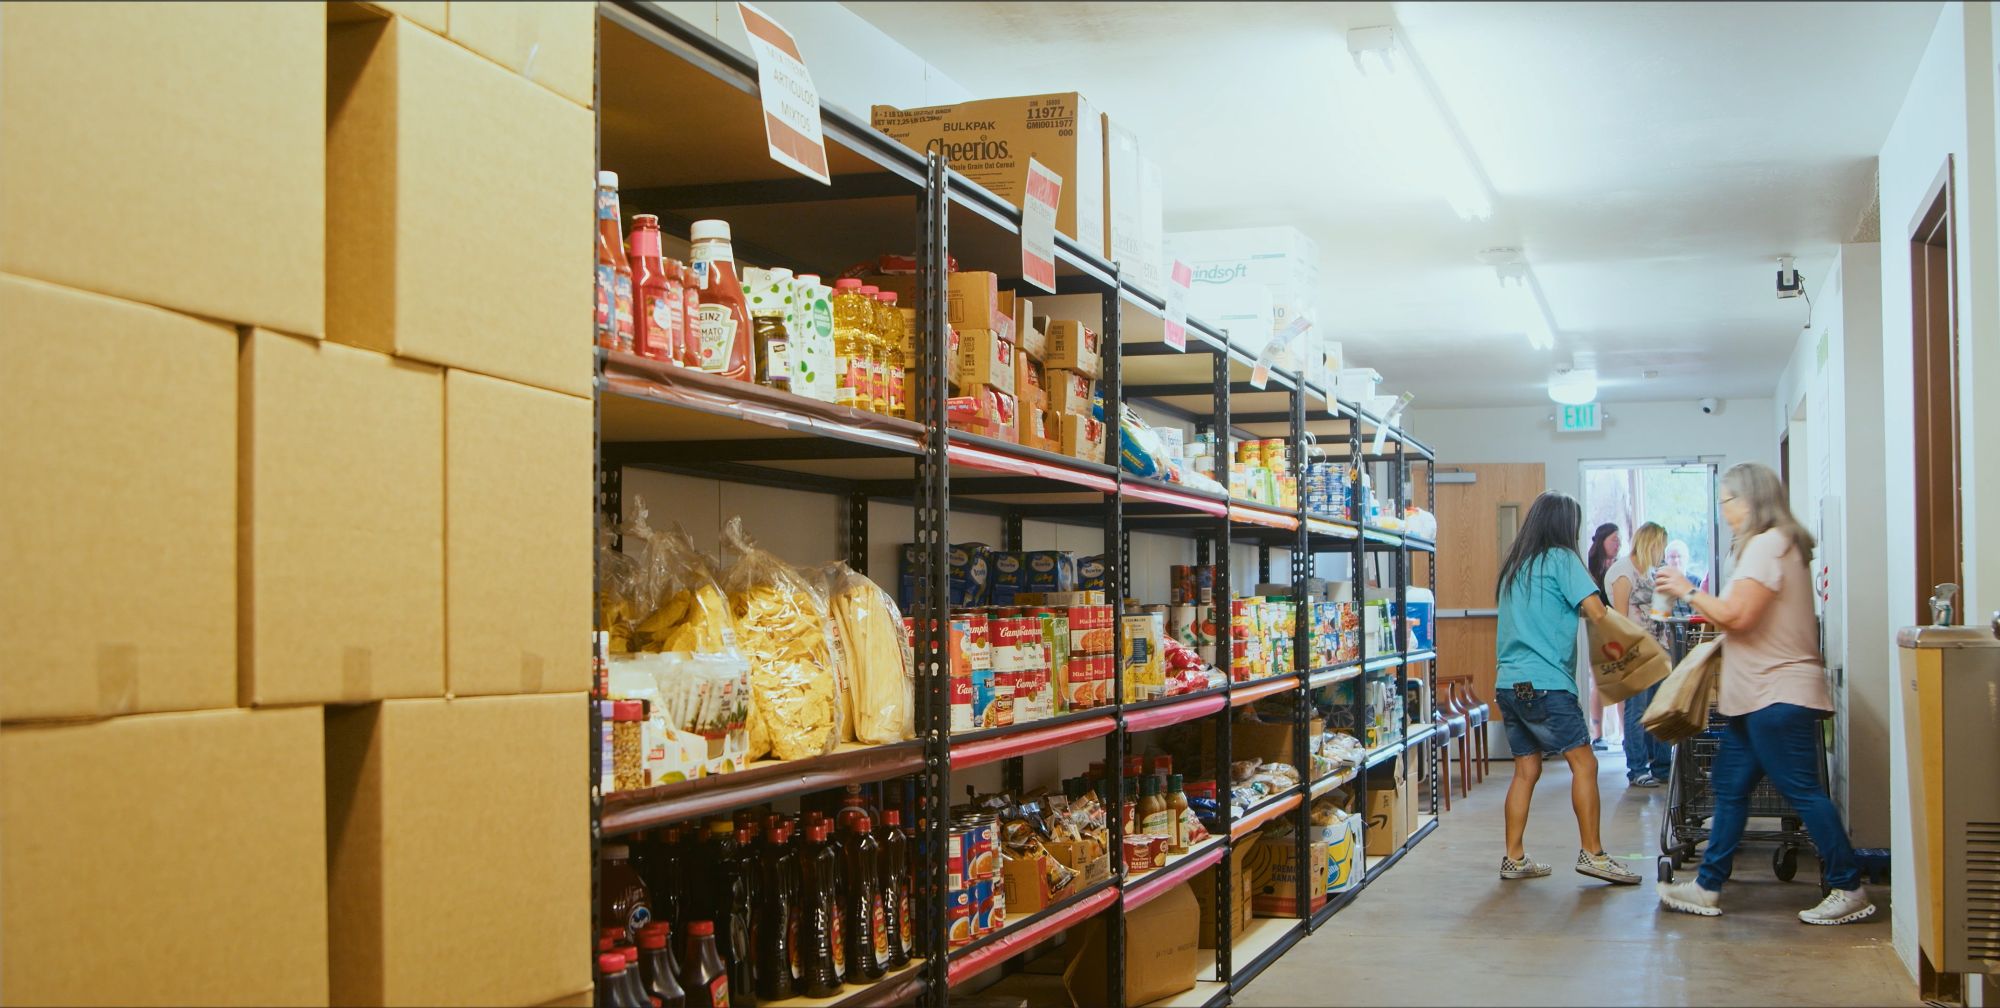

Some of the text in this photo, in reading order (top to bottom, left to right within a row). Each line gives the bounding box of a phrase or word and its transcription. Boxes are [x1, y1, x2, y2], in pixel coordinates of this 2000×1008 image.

[781, 100, 811, 132] MIXTOS
[1027, 106, 1065, 119] 11977
[943, 121, 997, 132] BULKPAK
[1058, 128, 1073, 136] 000
[926, 137, 1009, 162] Cheerios
[995, 161, 1015, 169] Cereal
[1192, 263, 1247, 284] indsoft
[700, 312, 720, 321] EINZ
[702, 327, 723, 335] MATO
[1564, 404, 1595, 429] EXIT
[1601, 645, 1640, 676] SAFEWAY
